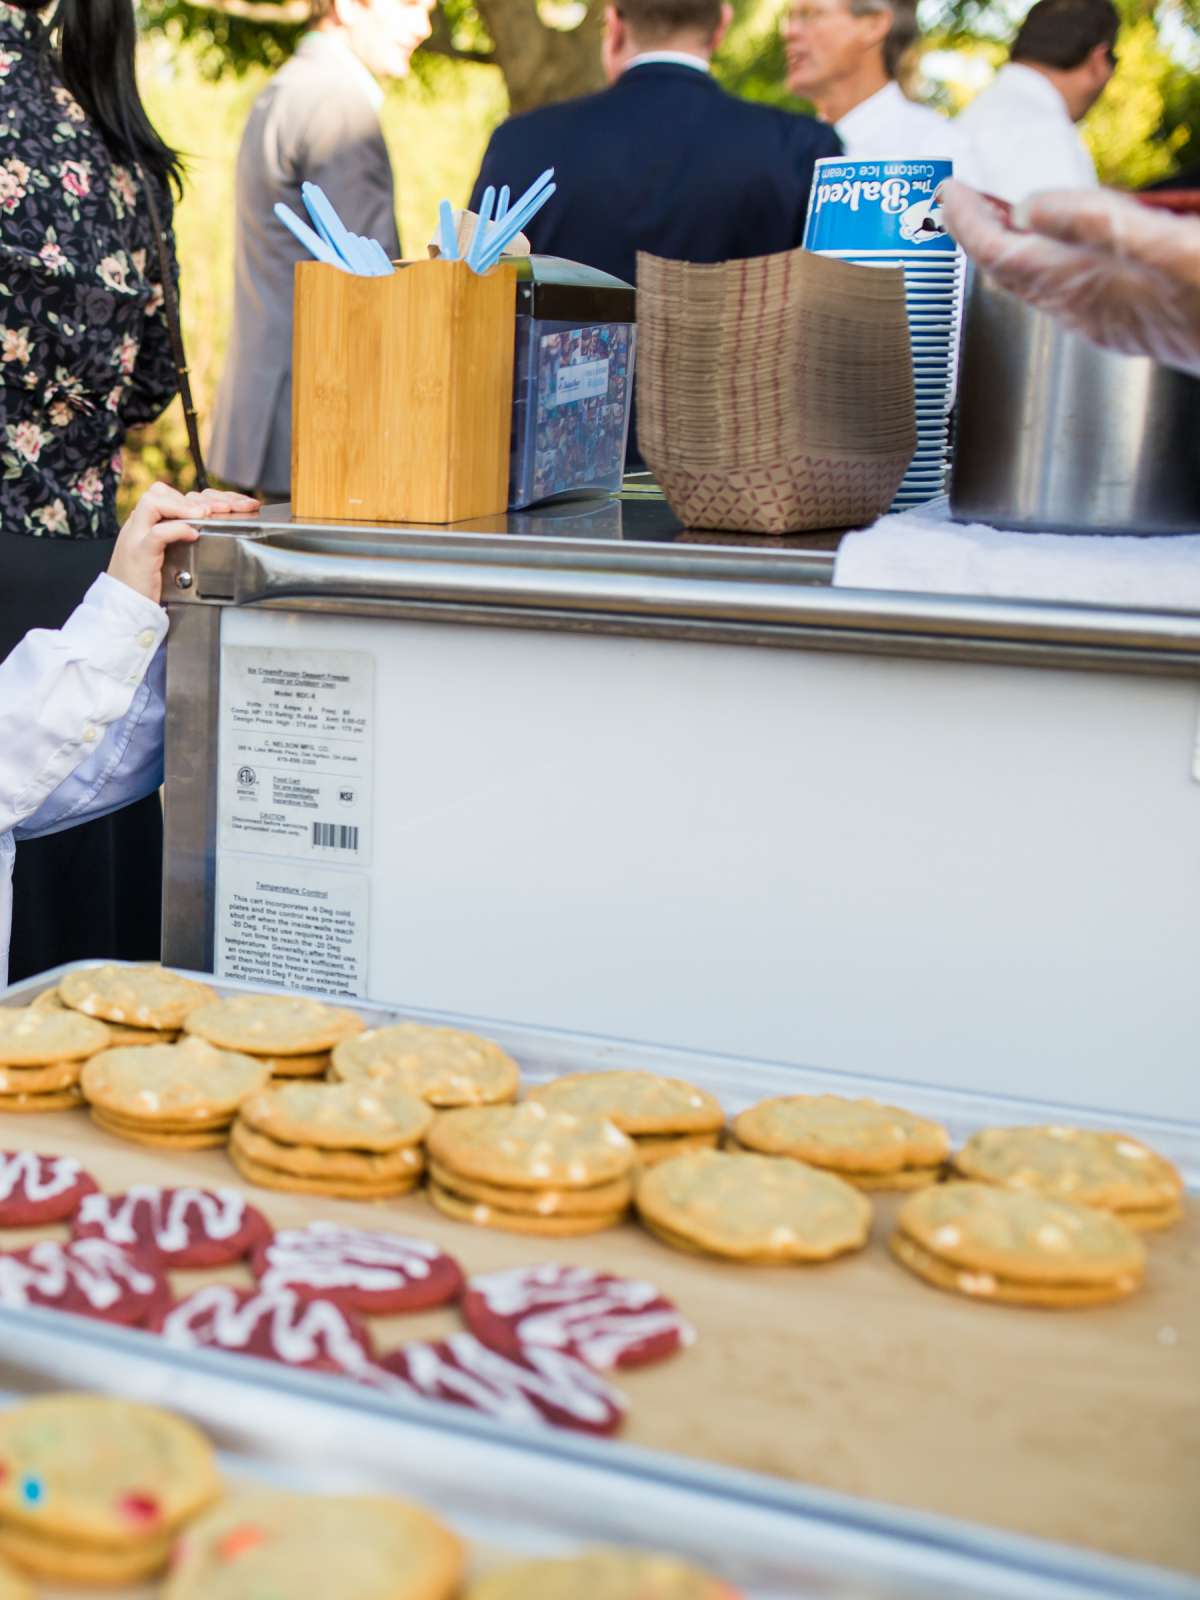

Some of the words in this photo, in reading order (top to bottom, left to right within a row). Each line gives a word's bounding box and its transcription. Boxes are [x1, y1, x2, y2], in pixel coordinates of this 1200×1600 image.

[820, 166, 856, 180] Cream
[858, 164, 881, 178] Ice
[883, 163, 936, 178] Custom
[912, 178, 934, 193] The
[814, 178, 911, 215] Baked
[340, 791, 354, 801] NSF
[256, 881, 299, 894] Temperature
[301, 887, 328, 898] Control
[228, 903, 249, 912] plates
[251, 906, 264, 914] and
[266, 906, 277, 915] the
[233, 894, 248, 903] This
[264, 899, 309, 911] incorporates
[257, 916, 277, 924] when
[254, 931, 270, 940] time
[280, 936, 300, 945] reach
[301, 938, 313, 947] the
[294, 929, 323, 940] requires
